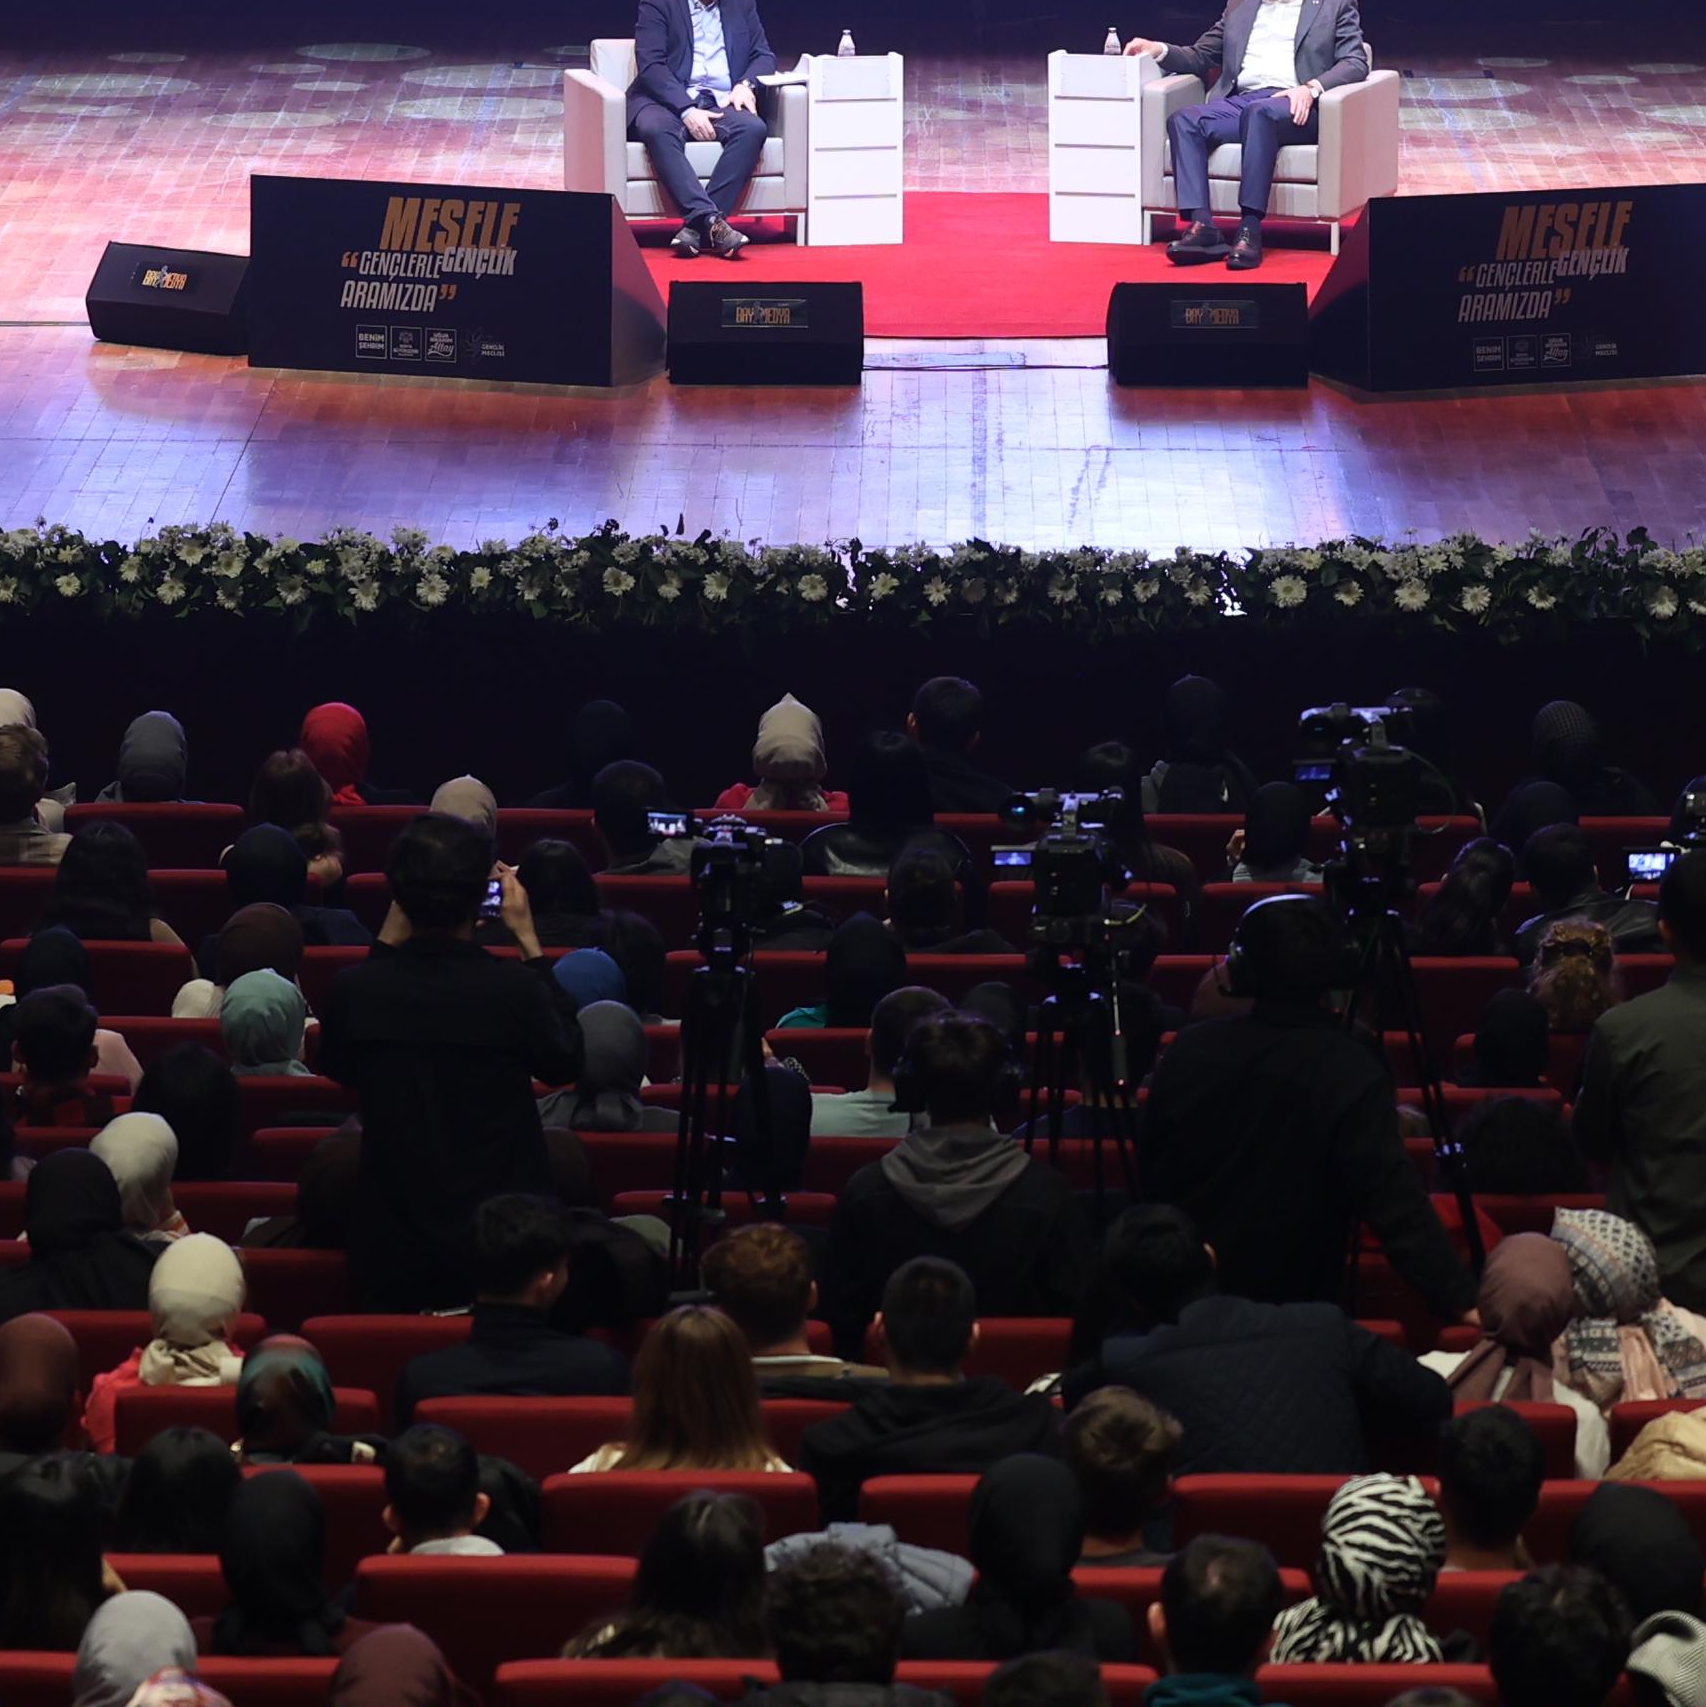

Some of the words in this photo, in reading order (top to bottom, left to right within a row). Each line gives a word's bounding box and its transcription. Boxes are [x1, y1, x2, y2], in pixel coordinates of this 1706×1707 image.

[379, 196, 521, 255] MESELE
[1495, 201, 1634, 261] MESELE
[442, 243, 518, 279] GENÇLİK
